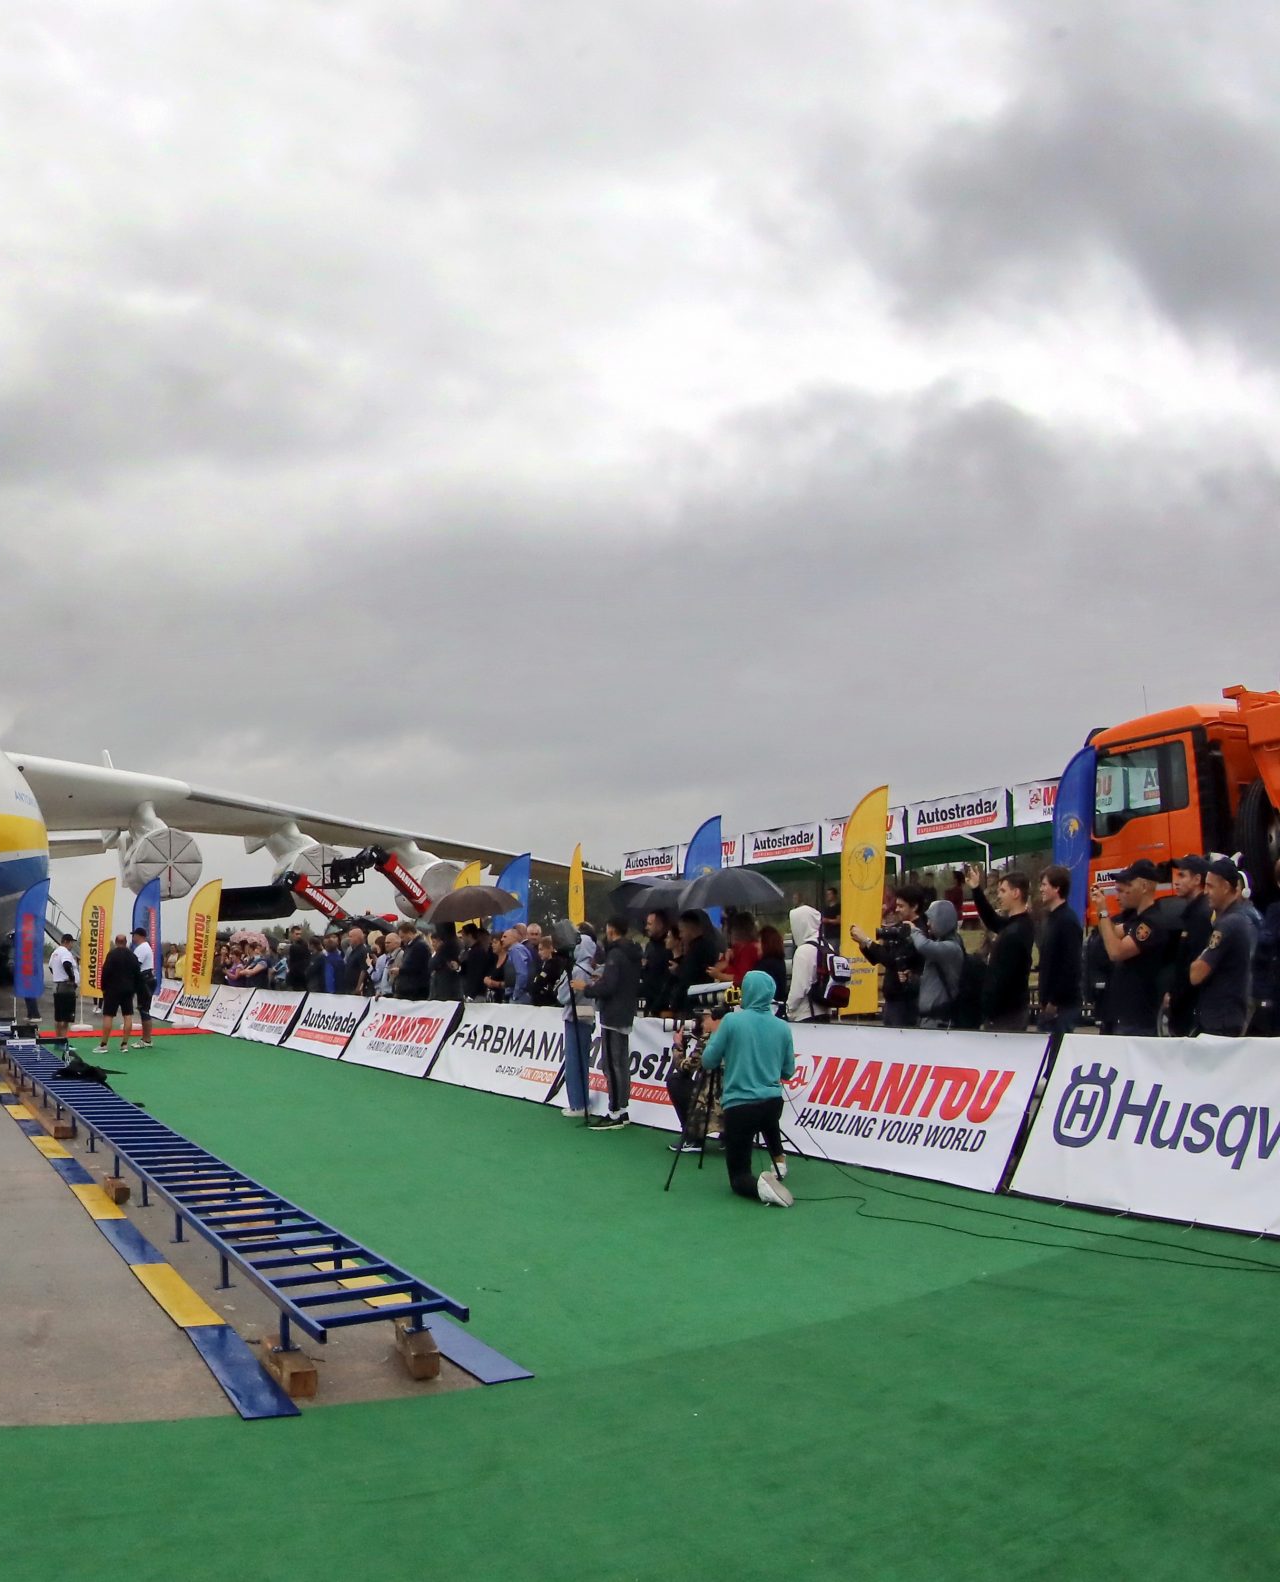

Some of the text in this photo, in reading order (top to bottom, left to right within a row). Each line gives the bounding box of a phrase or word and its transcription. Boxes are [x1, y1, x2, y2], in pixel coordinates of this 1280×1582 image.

[917, 798, 991, 825] Autostrada
[753, 830, 809, 851] Autostrada
[625, 853, 669, 869] Autostrada
[394, 866, 422, 897] MANITOU
[305, 887, 334, 911] MANITOU
[88, 911, 99, 988] Autostrada
[192, 913, 205, 975] MANITOU
[301, 1007, 356, 1034] Autostrada
[375, 1014, 444, 1045] MANITOU
[808, 1057, 1016, 1124] MANITOU
[795, 1107, 987, 1152] HANDLING YOUR WORLD
[1107, 1079, 1280, 1170] Husqv
